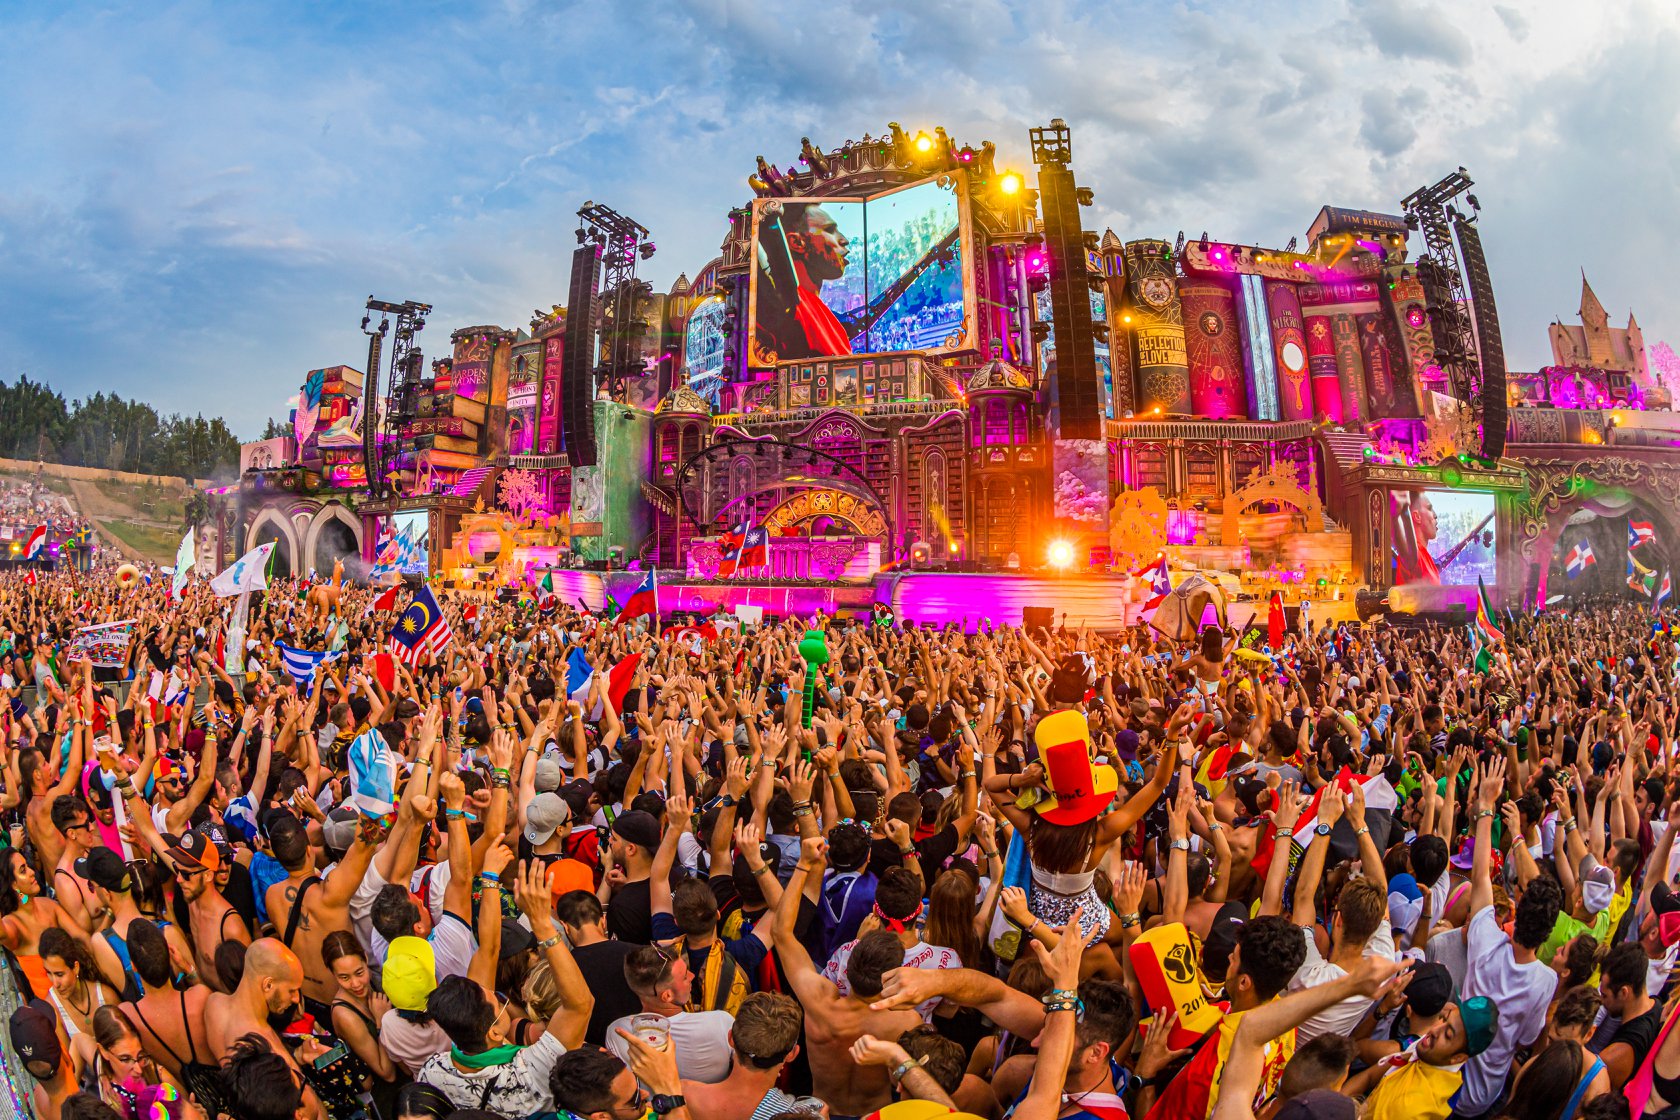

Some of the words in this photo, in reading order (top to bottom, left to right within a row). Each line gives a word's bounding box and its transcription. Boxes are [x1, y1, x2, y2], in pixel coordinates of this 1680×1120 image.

[1341, 214, 1360, 224] TIM
[1138, 336, 1186, 351] REFLECTION
[1146, 350, 1168, 364] LOVE
[452, 368, 487, 380] GARDEN
